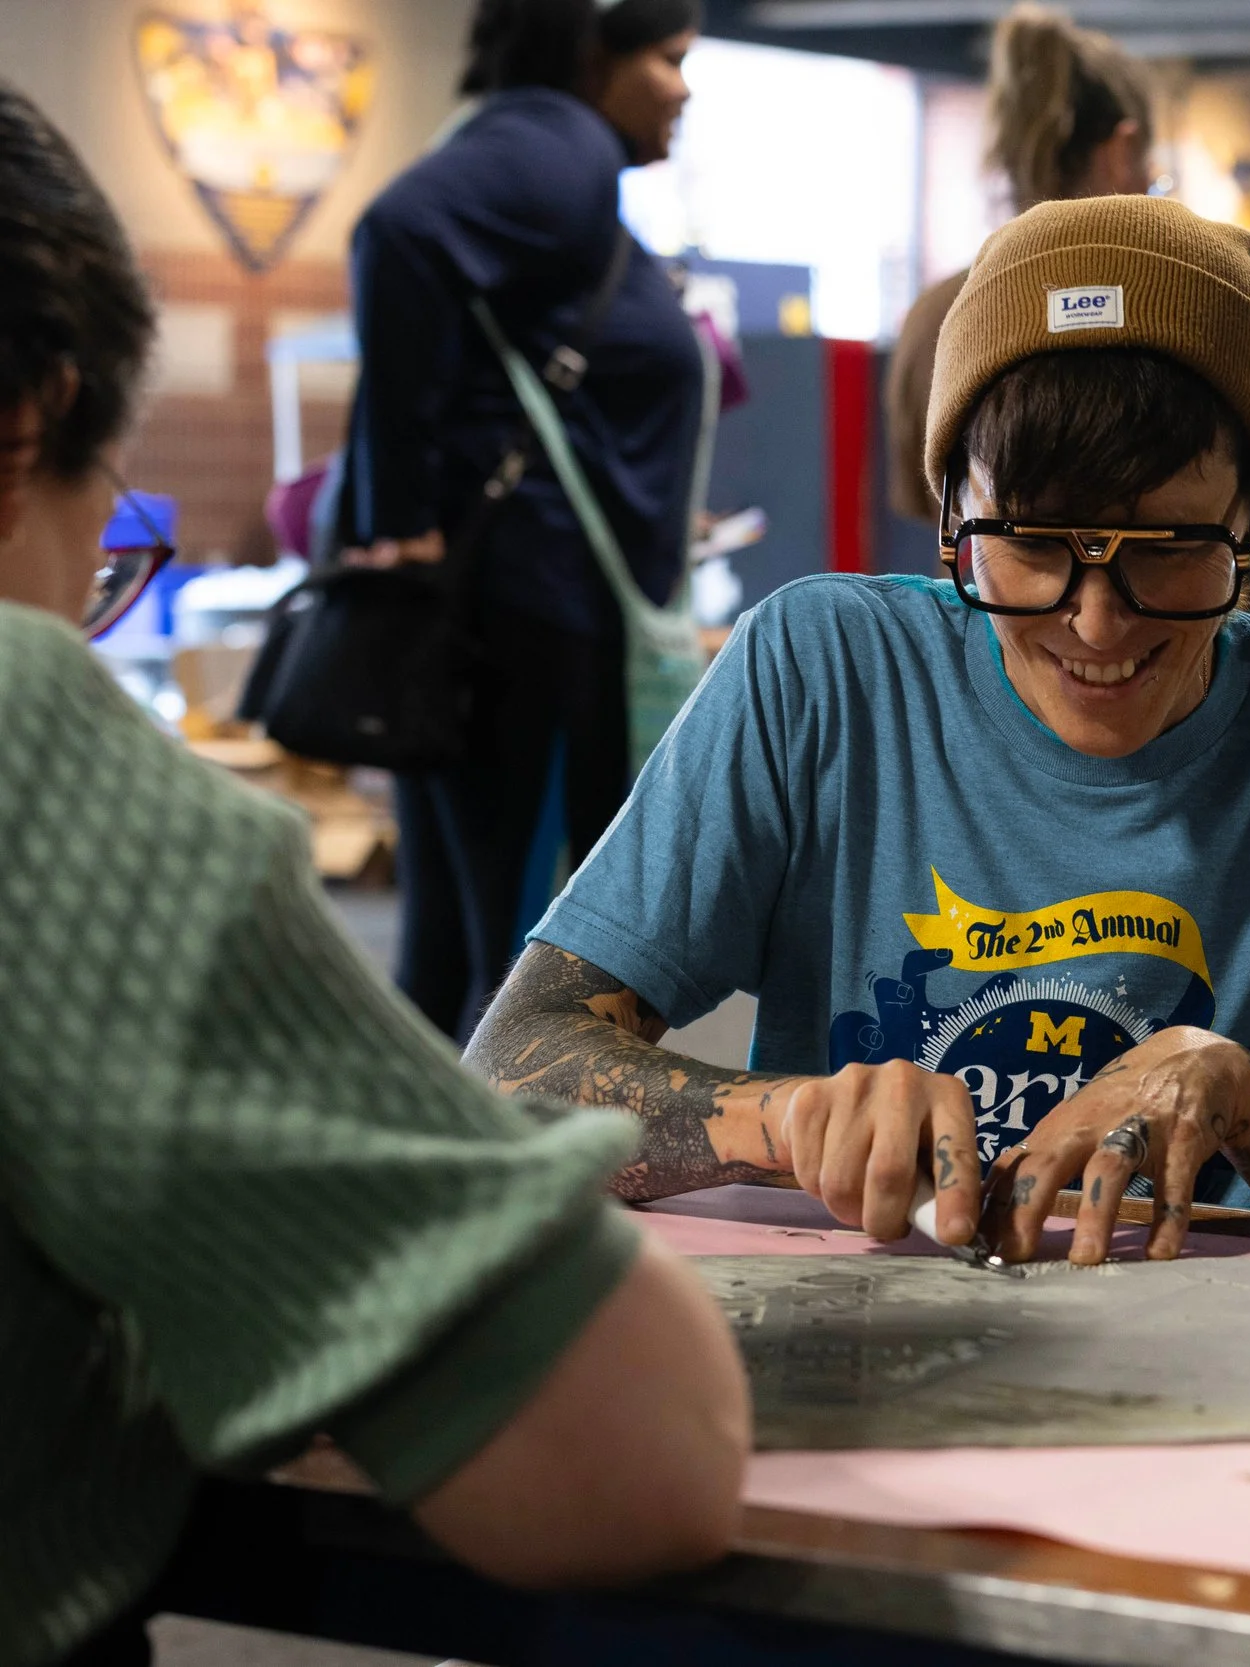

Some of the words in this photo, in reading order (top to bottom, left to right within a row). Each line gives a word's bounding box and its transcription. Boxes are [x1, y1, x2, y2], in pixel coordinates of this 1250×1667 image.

[966, 917, 1021, 960] The
[1025, 917, 1066, 953] 2nd
[1072, 907, 1182, 948] Annual
[1025, 1010, 1087, 1057] M
